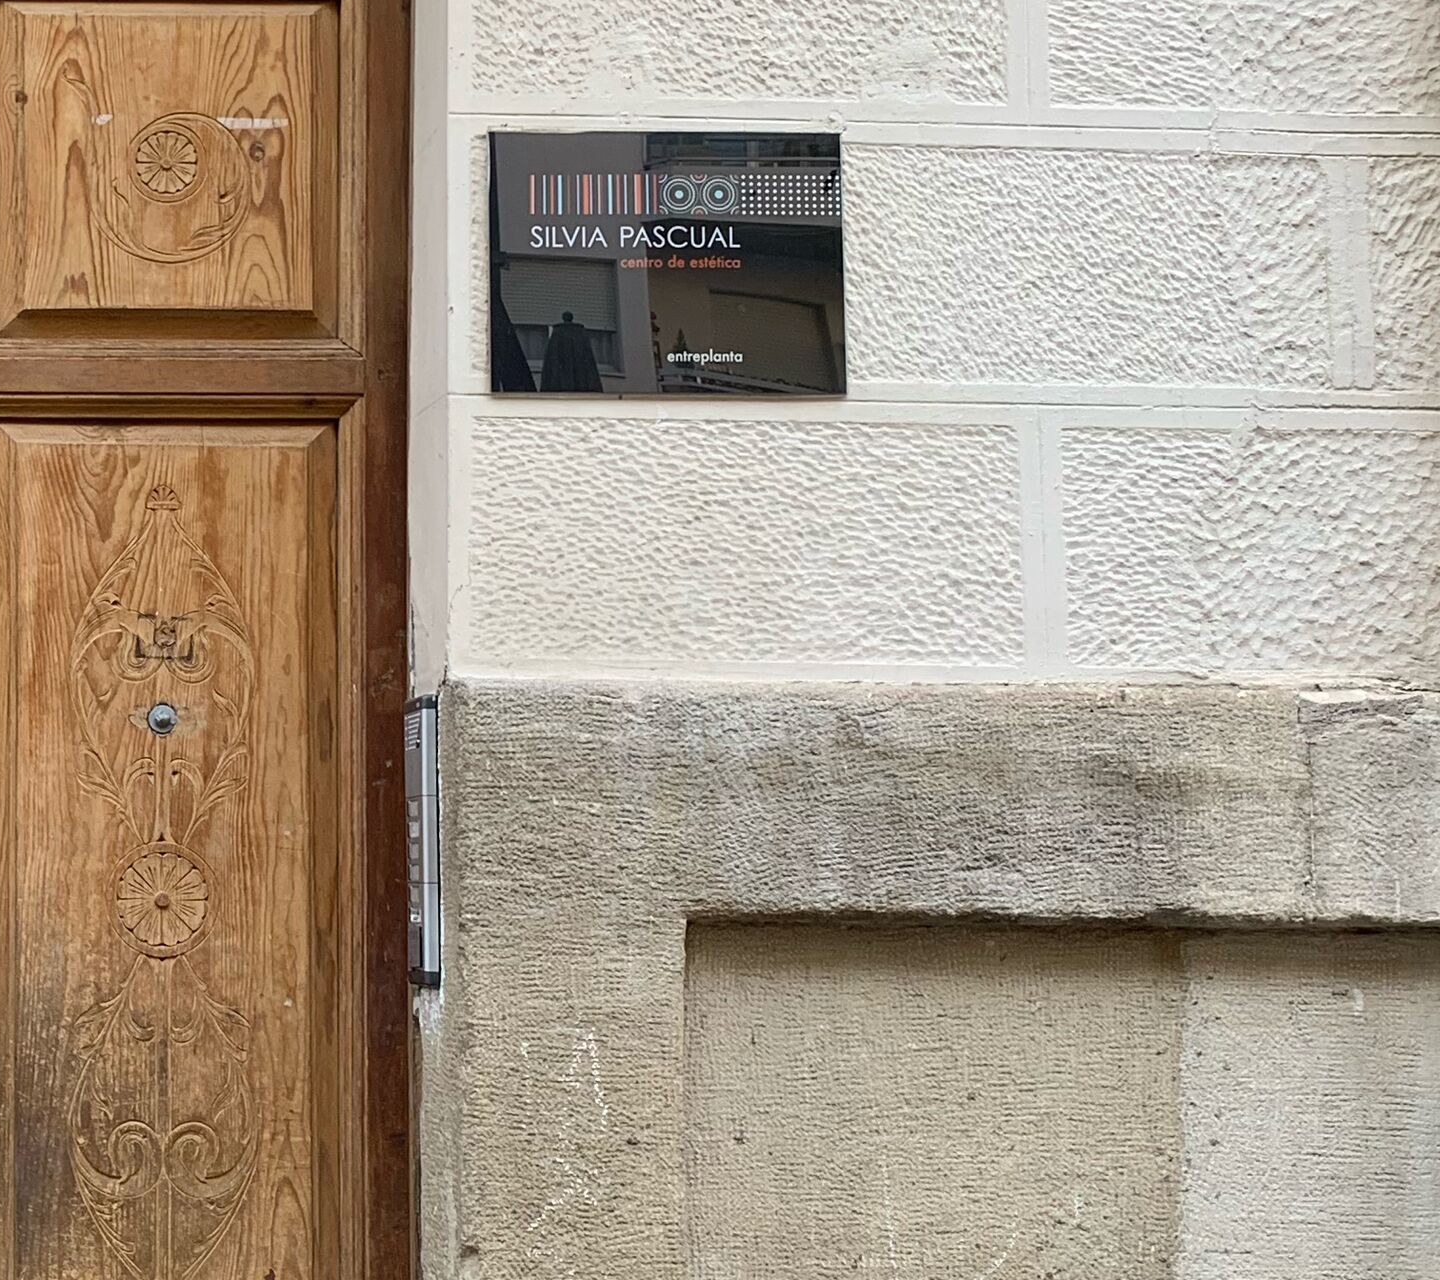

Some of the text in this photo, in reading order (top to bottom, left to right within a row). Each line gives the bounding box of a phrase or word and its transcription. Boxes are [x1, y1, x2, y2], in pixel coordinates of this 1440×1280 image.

[529, 225, 741, 249] SILVIA PASCUAL
[620, 254, 742, 269] centro de estética
[666, 348, 743, 366] entreplanta
